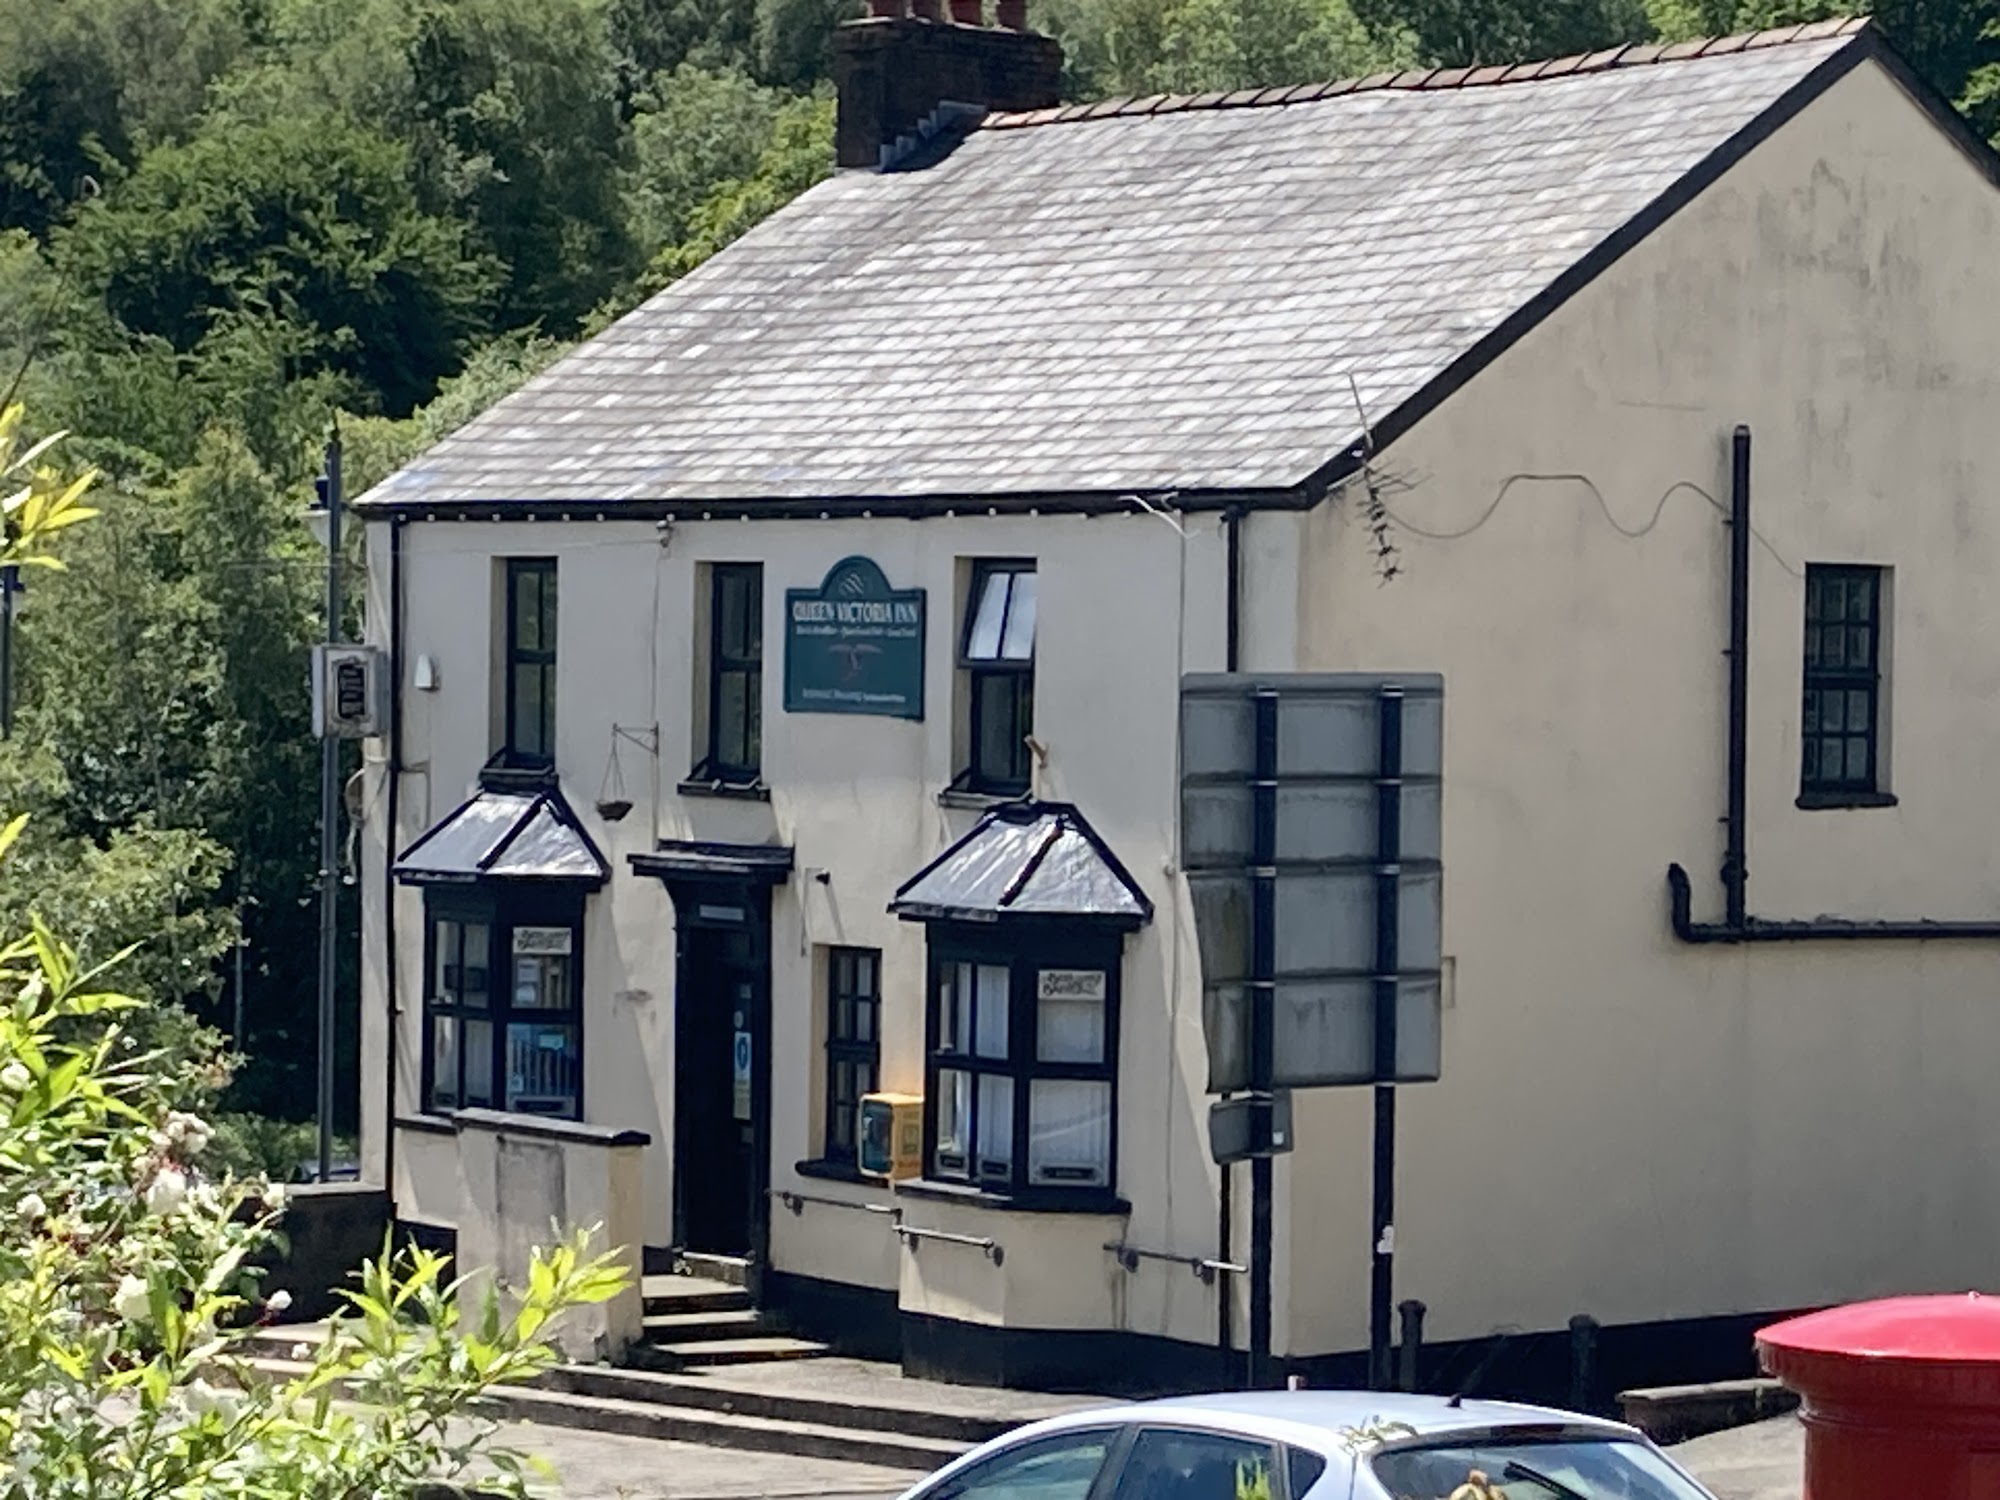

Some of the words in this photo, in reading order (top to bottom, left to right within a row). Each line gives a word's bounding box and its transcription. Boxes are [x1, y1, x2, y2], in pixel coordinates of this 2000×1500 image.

[793, 600, 835, 621] QUEEN
[836, 601, 893, 622] VICTORIA
[895, 602, 918, 623] INN
